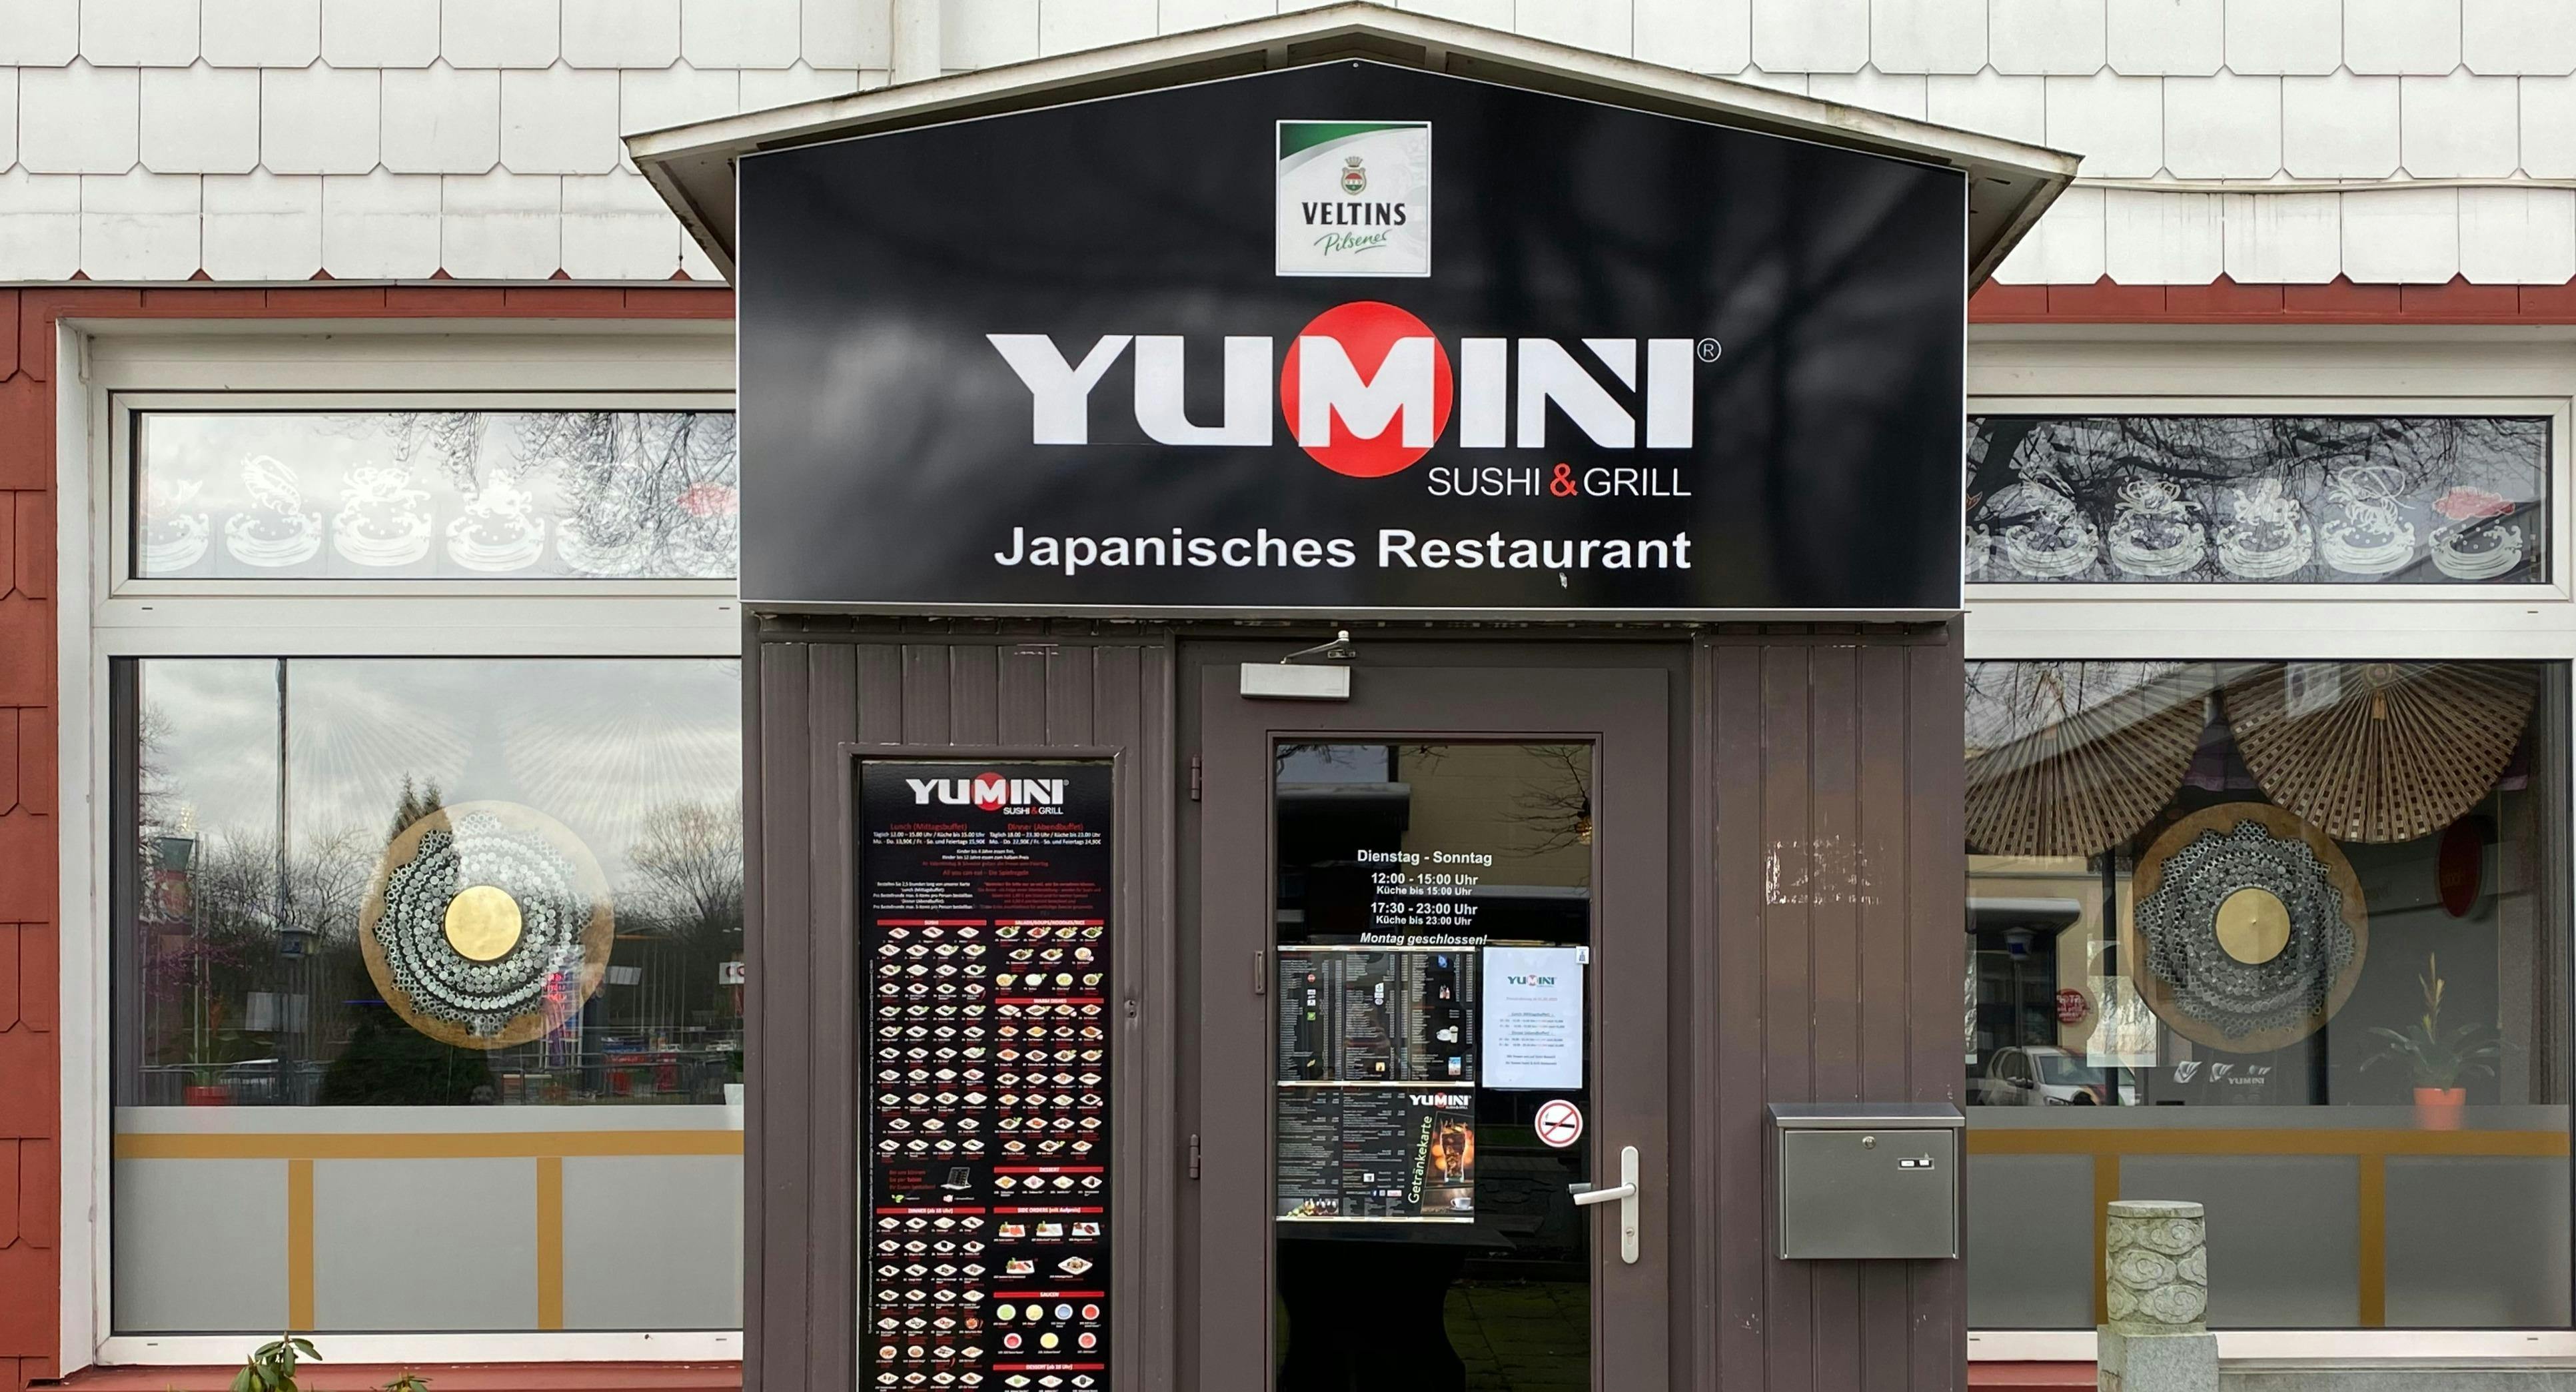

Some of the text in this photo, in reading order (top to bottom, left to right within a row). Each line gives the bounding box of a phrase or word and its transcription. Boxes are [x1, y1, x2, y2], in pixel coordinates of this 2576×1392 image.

[1301, 201, 1407, 227] VELTINS
[1313, 229, 1393, 256] Pilsener
[986, 334, 1694, 448] YUMINI
[1427, 463, 1692, 497] SUSHI & GRILL
[993, 526, 1691, 575] Japanisches Restaurant
[906, 779, 1063, 805] YUMINI
[1357, 850, 1420, 865] Dienstag
[1433, 851, 1492, 866] Sonntag
[1371, 873, 1405, 884] 12:00
[1417, 874, 1451, 885] 15:00
[1455, 874, 1478, 886] Uhr
[1376, 886, 1473, 896] Küche bis 15:00 Uhr
[1371, 902, 1404, 914] 17:30
[1416, 903, 1450, 914] 23:00
[1454, 904, 1478, 915] Uhr
[1376, 915, 1472, 926] Küche bis 23:00 Uhr
[1360, 932, 1487, 946] Montag geschlossen!
[1409, 1095, 1469, 1106] YUMINI
[1408, 1115, 1433, 1203] Getränkekarte
